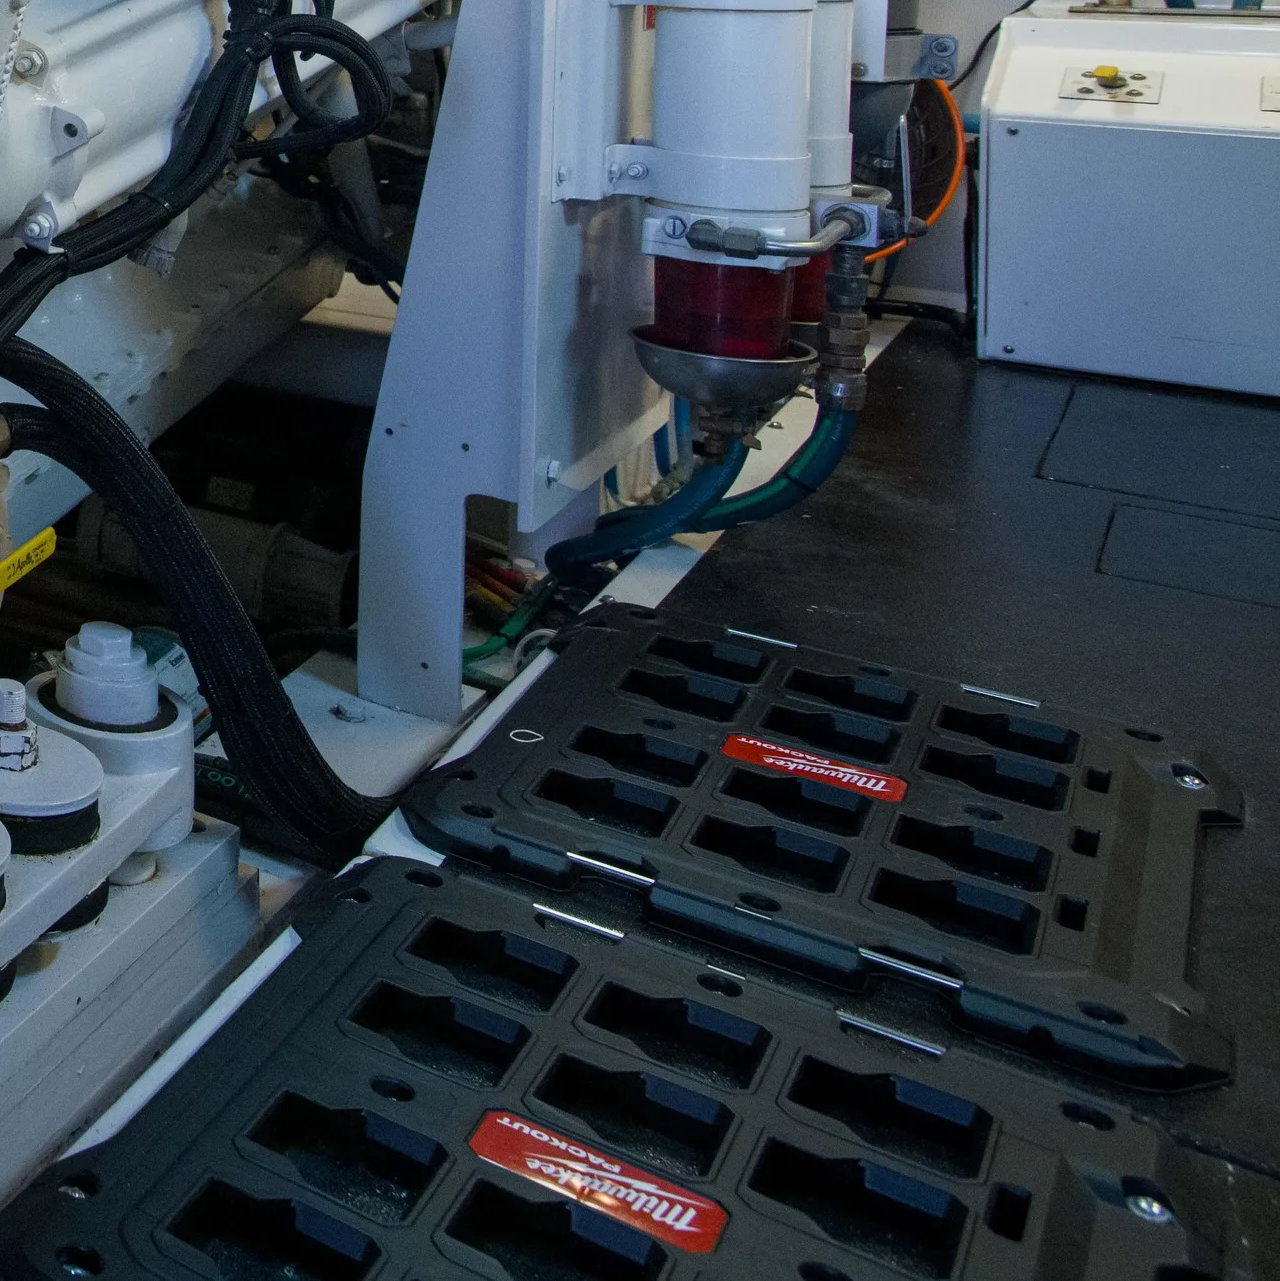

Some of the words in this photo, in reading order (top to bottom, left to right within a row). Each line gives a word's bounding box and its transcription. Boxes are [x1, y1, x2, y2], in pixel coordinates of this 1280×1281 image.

[737, 737, 830, 765] PACKOUT
[763, 756, 892, 792] Milwaukee
[497, 1116, 621, 1174] PACKOUT
[525, 1157, 701, 1233] Milwaukee
